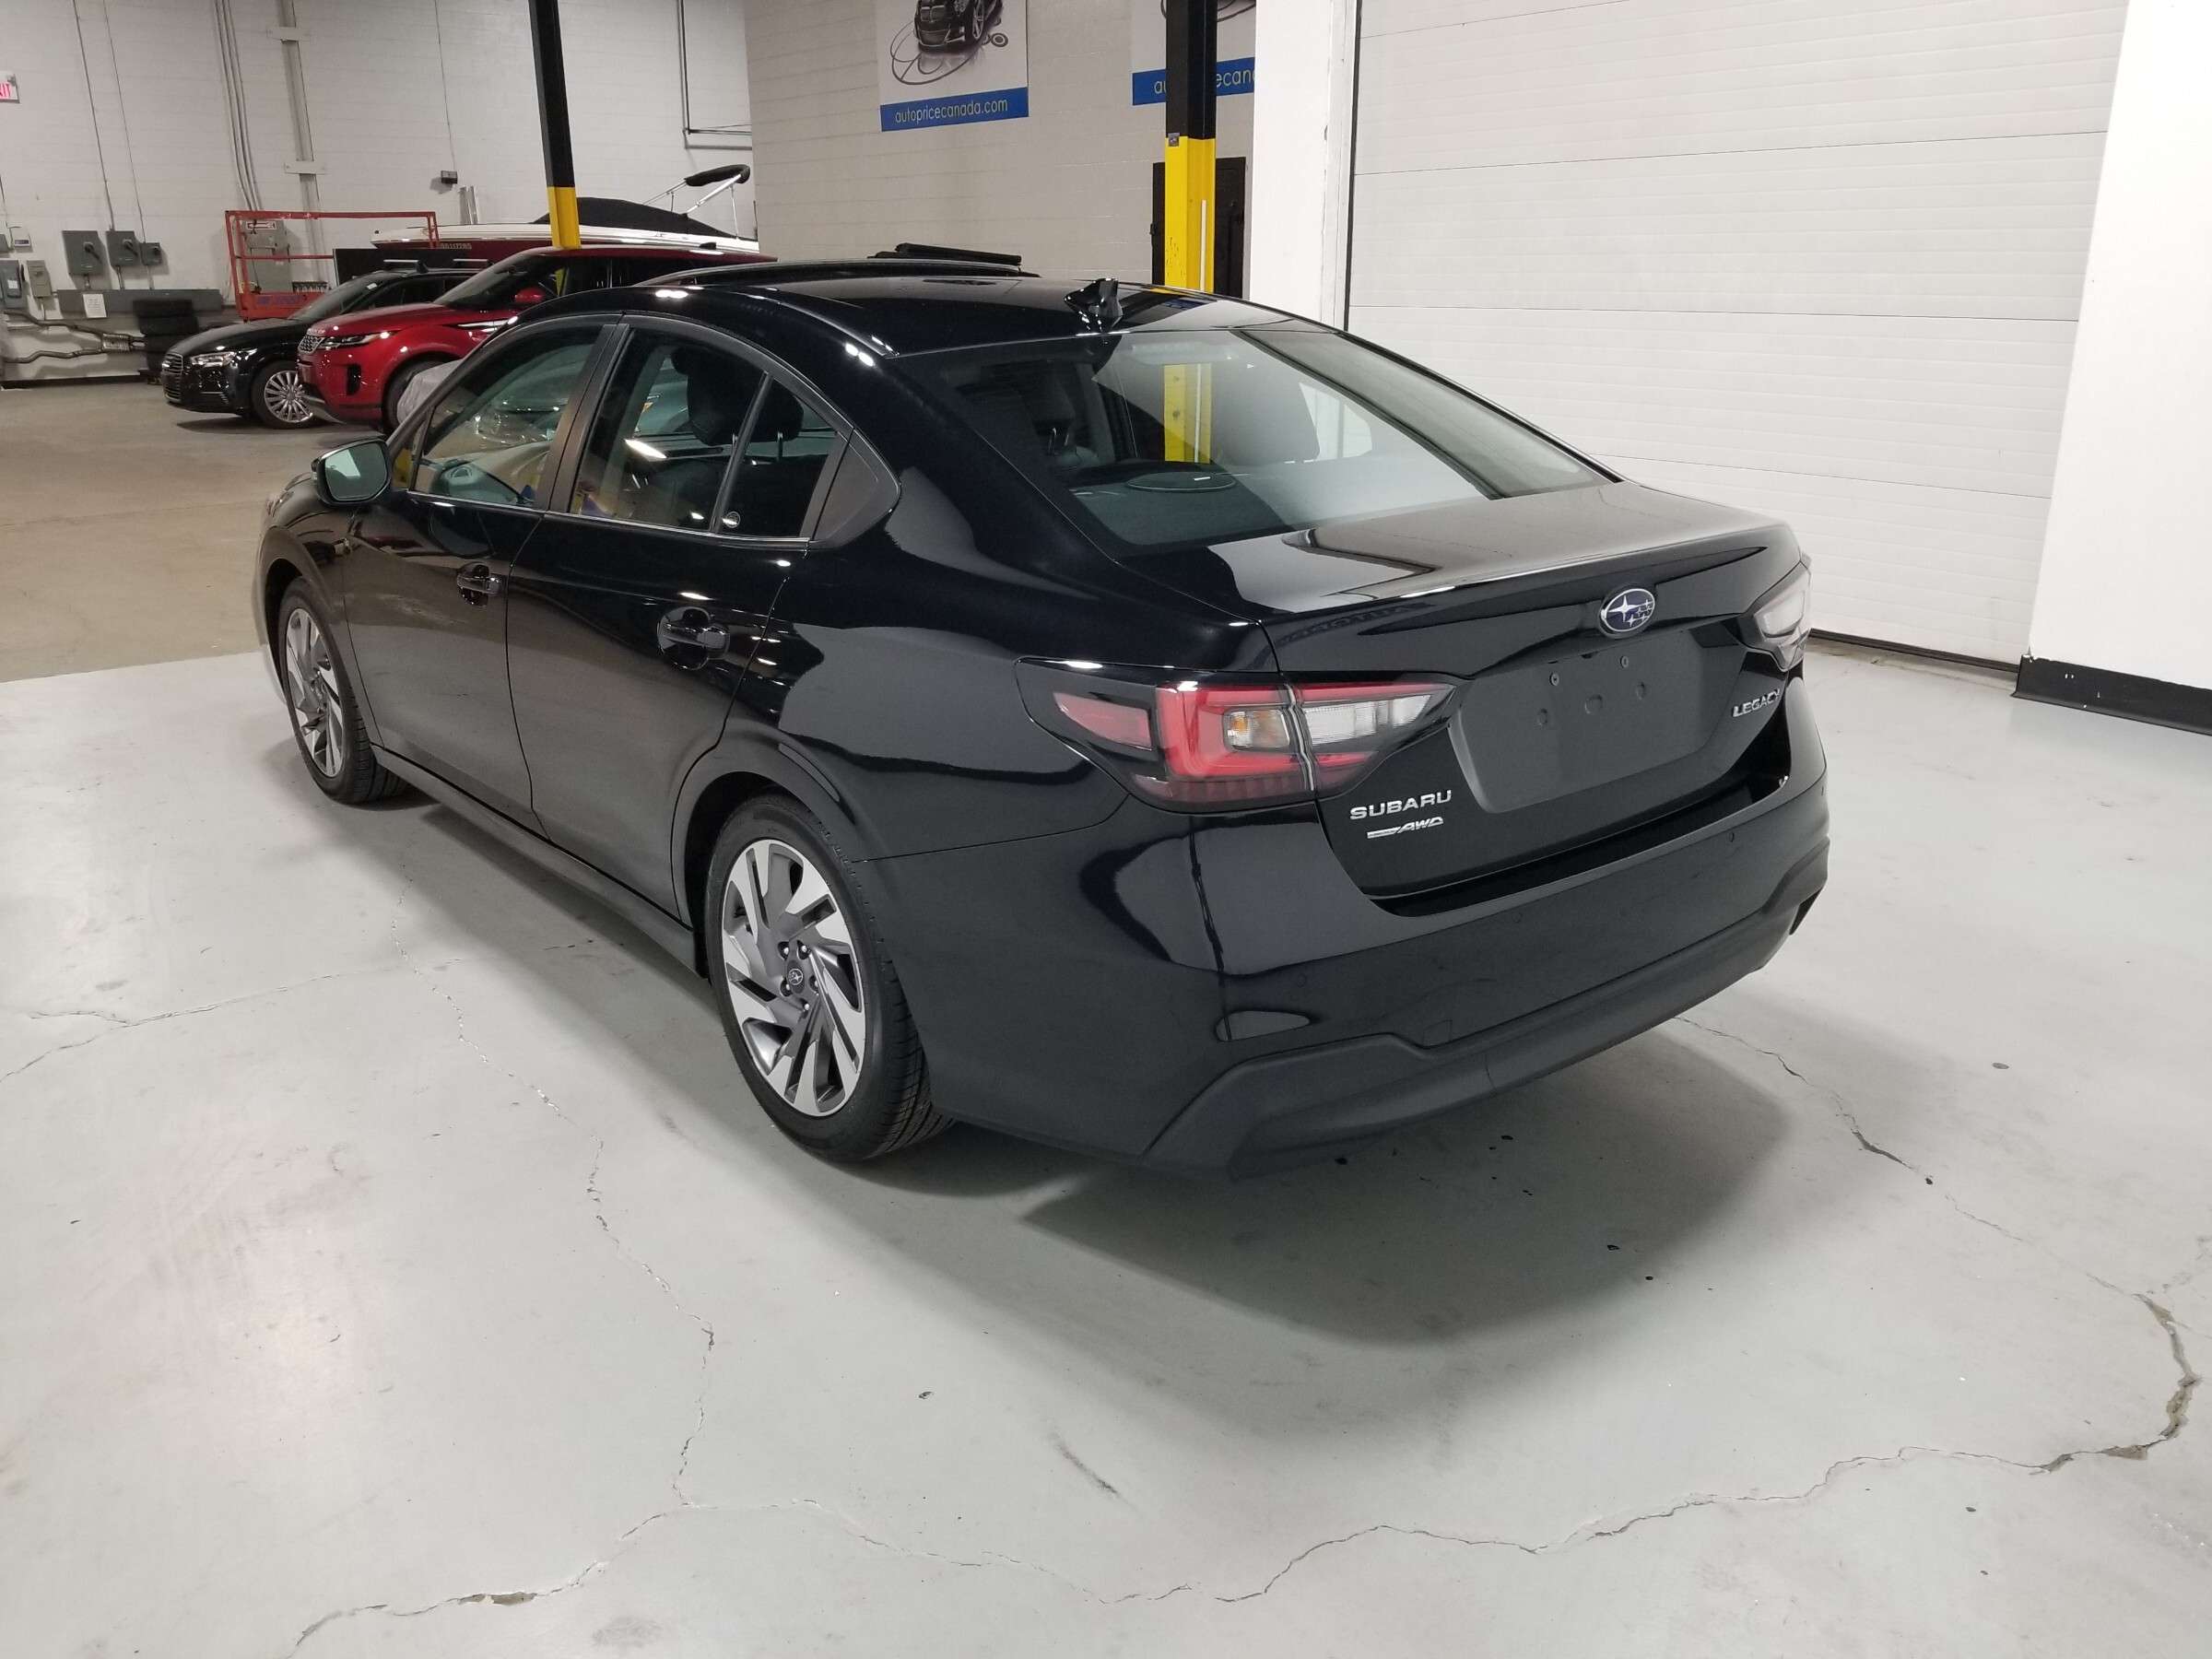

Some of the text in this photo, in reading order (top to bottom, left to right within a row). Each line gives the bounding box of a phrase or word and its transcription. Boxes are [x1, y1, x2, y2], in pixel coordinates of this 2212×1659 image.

[895, 99, 1008, 124] autopricecanada.com
[1733, 688, 1781, 717] LEGACY
[1349, 790, 1452, 820] SUBARU
[1396, 816, 1444, 833] AWD
